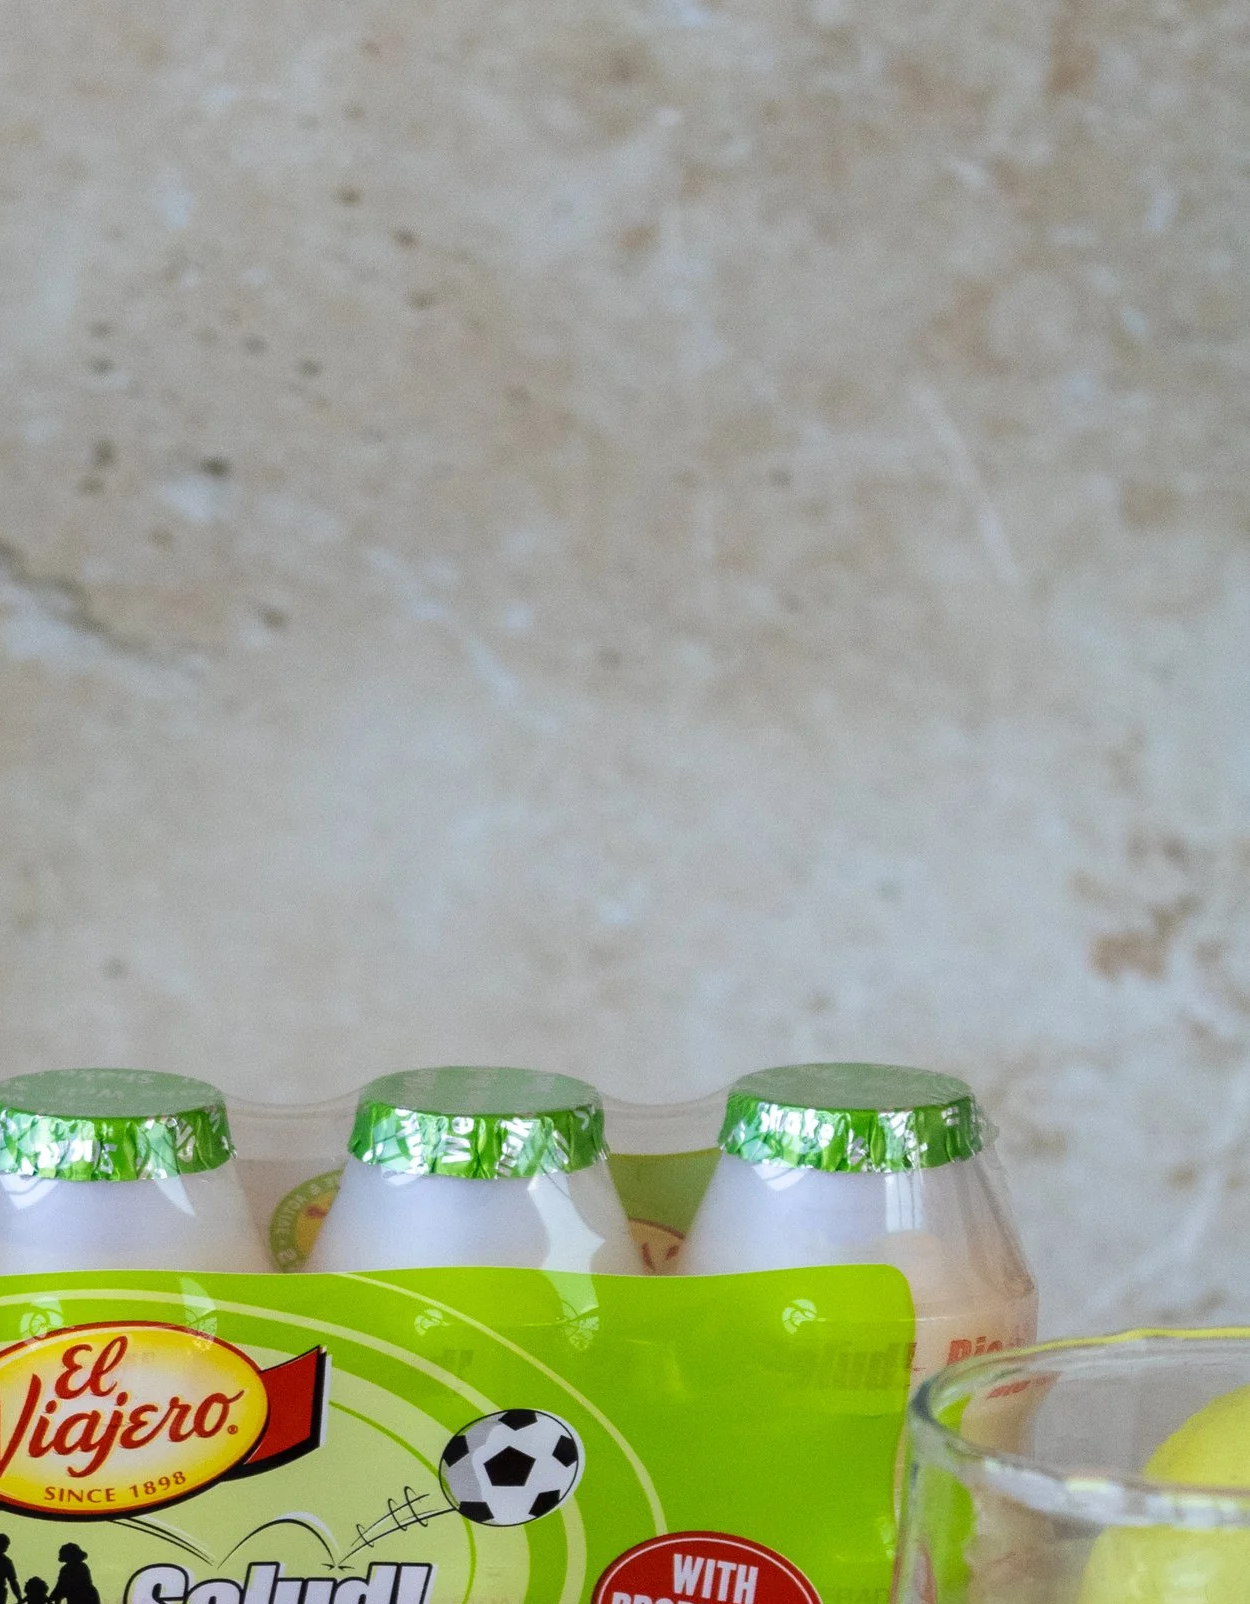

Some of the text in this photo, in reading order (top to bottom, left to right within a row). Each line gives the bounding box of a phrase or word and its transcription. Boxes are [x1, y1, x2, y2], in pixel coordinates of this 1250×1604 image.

[53, 1335, 129, 1400] El
[43, 1470, 188, 1504] SINCE 1898
